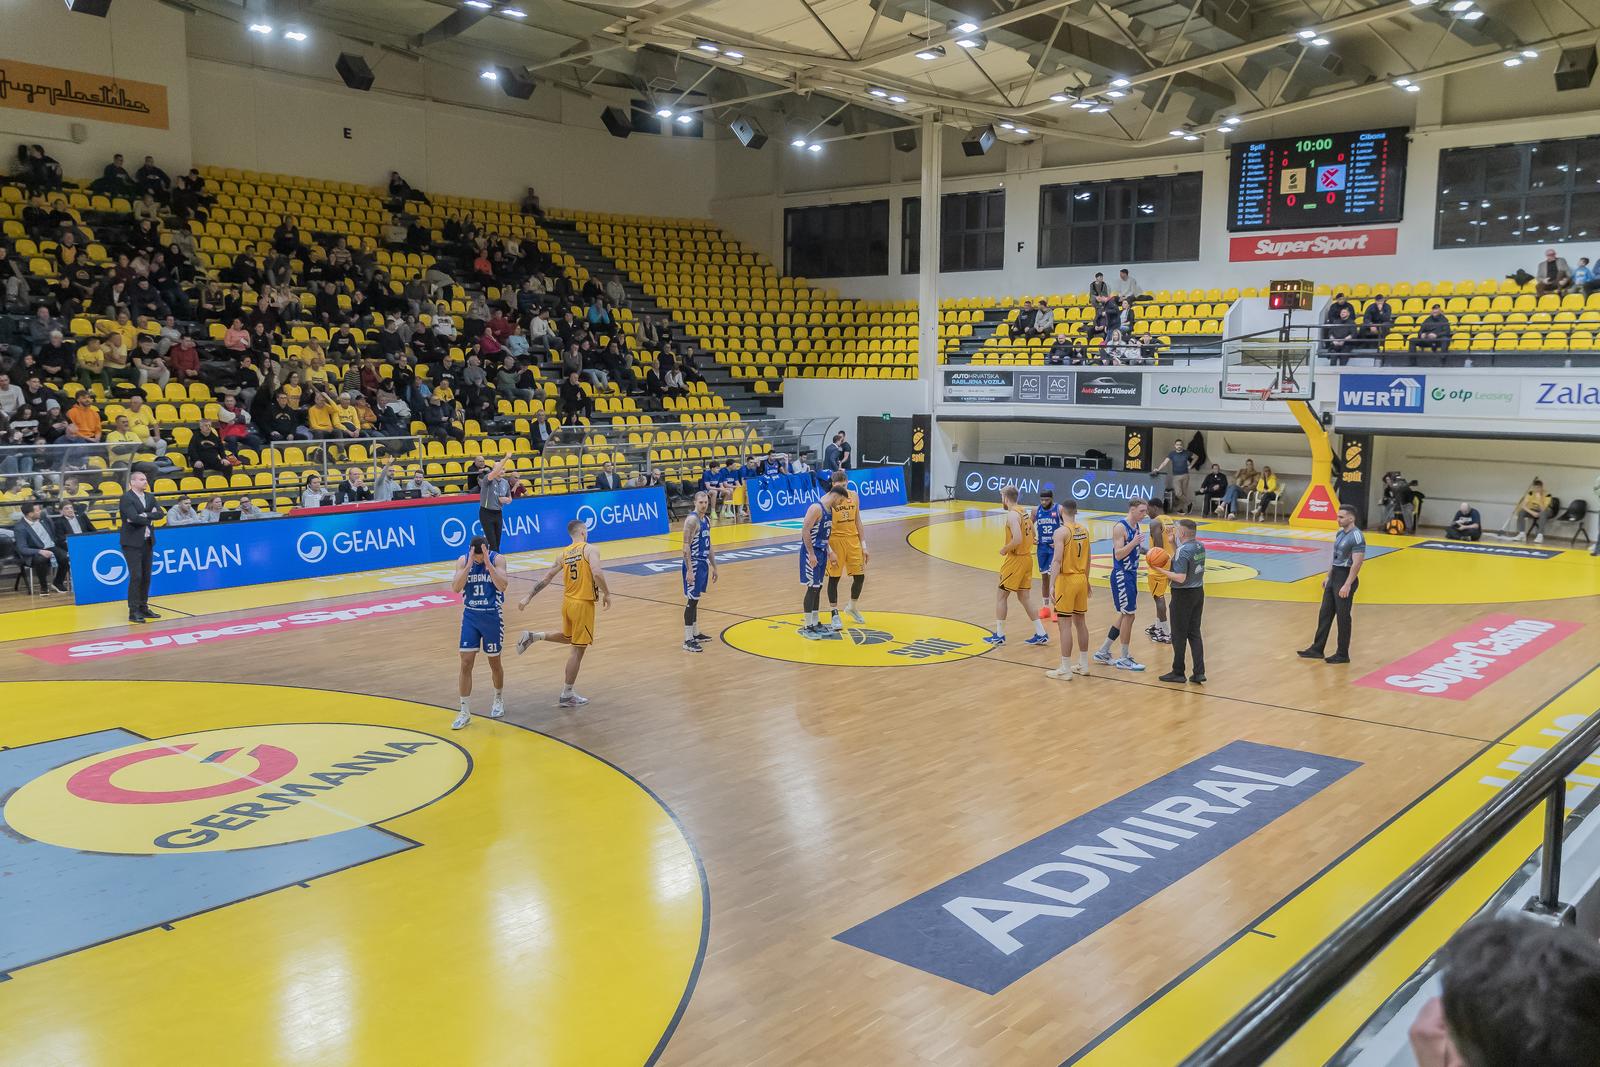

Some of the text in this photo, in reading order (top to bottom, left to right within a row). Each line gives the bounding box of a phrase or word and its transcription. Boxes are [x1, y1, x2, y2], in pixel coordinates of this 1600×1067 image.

[343, 127, 353, 140] E
[1249, 143, 1266, 151] Split
[1296, 138, 1332, 152] 10:00
[1309, 159, 1315, 168] 1
[1286, 194, 1297, 207] 0
[1326, 191, 1336, 205] 0
[1017, 241, 1025, 253] F
[1255, 234, 1369, 256] SuperSport
[1022, 378, 1038, 388] AC
[1050, 378, 1066, 389] AC
[1449, 388, 1513, 402] otp Leasing
[860, 478, 900, 497] GEALAN
[1094, 483, 1154, 500] GEALAN
[600, 501, 658, 525] GEALAN
[1042, 525, 1053, 534] 32
[333, 525, 416, 555] GEALAN
[569, 562, 578, 580] 5
[473, 584, 485, 597] 31
[67, 594, 457, 658] SuperSport
[487, 643, 498, 653] 31
[1384, 619, 1556, 694] SuperCasino
[153, 741, 439, 850] GERMANIA
[941, 764, 1320, 956] ADMIRAL
